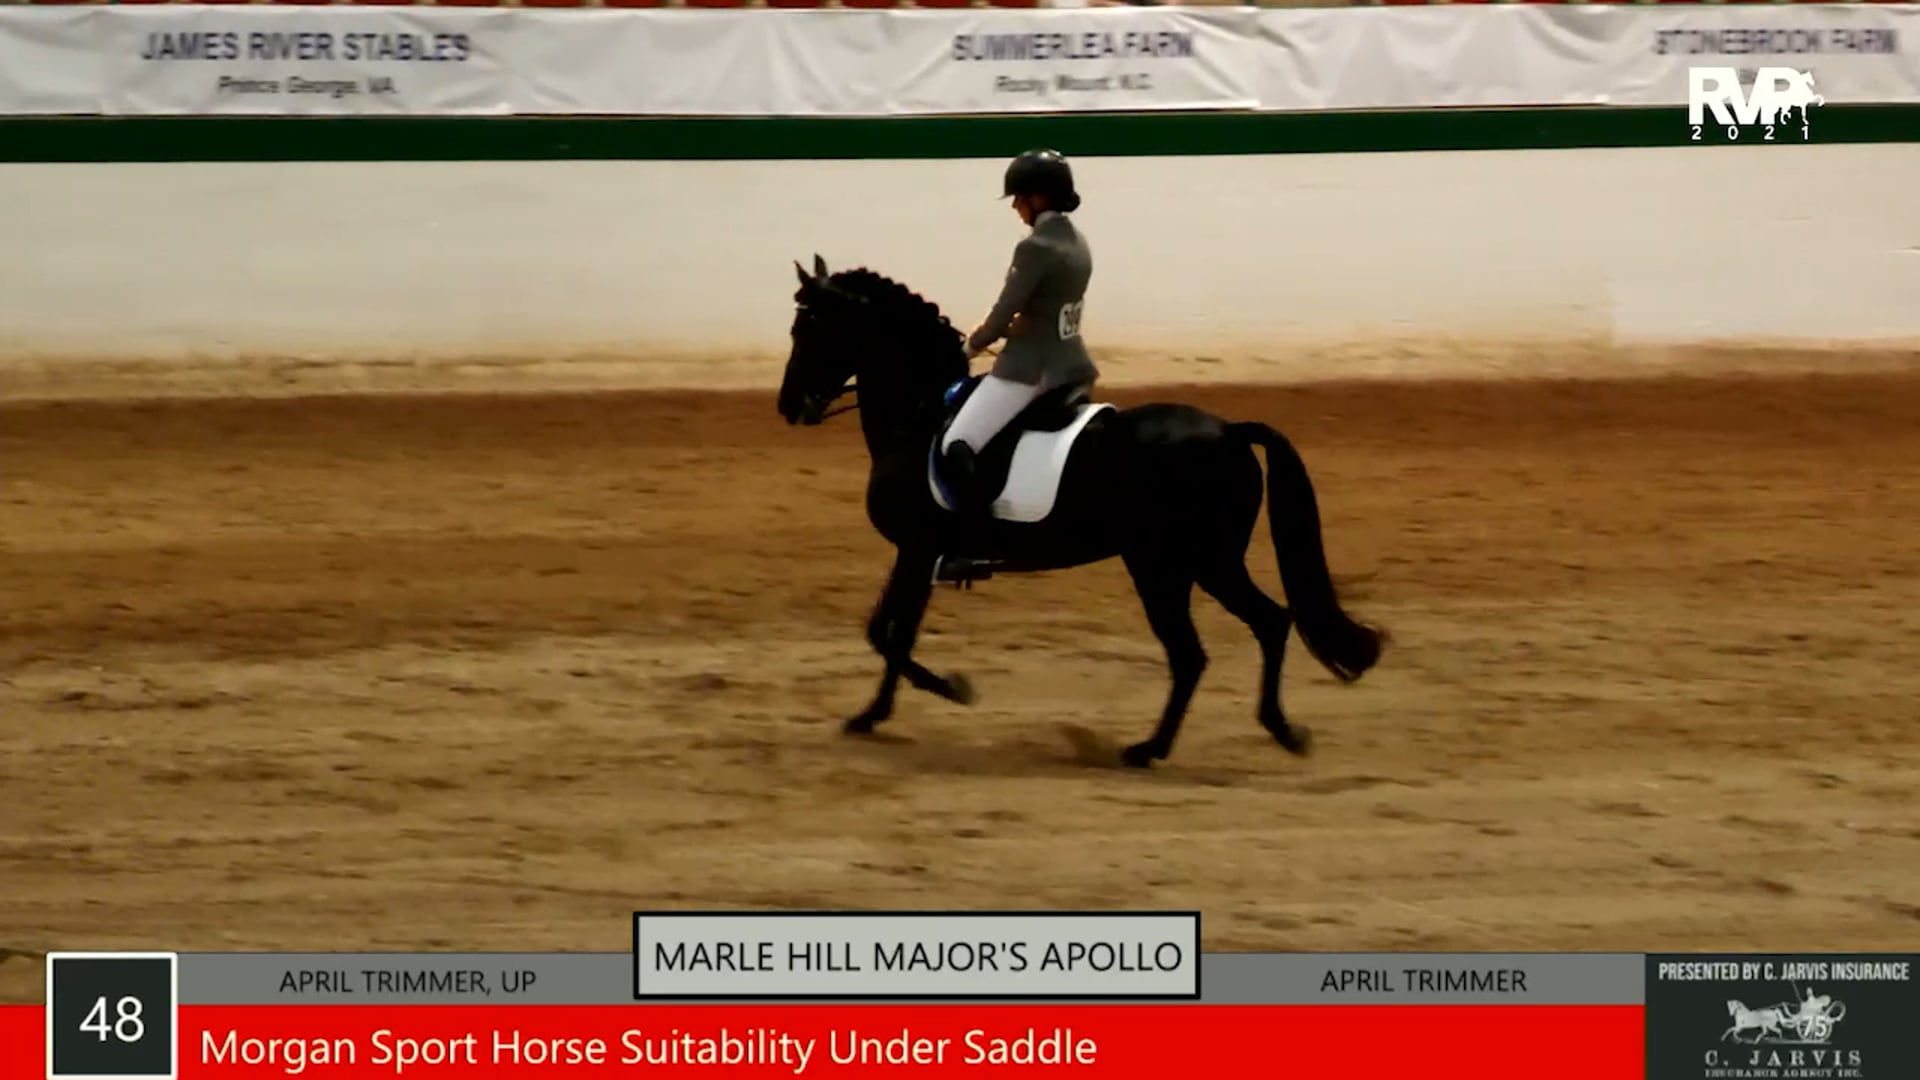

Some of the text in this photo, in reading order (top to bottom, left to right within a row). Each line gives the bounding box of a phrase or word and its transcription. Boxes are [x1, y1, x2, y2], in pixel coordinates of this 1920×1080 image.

[142, 32, 470, 62] JAMES RIVER STABLES
[1122, 31, 1194, 58] FARM
[1830, 29, 1896, 53] FARM
[218, 75, 278, 95] Prince
